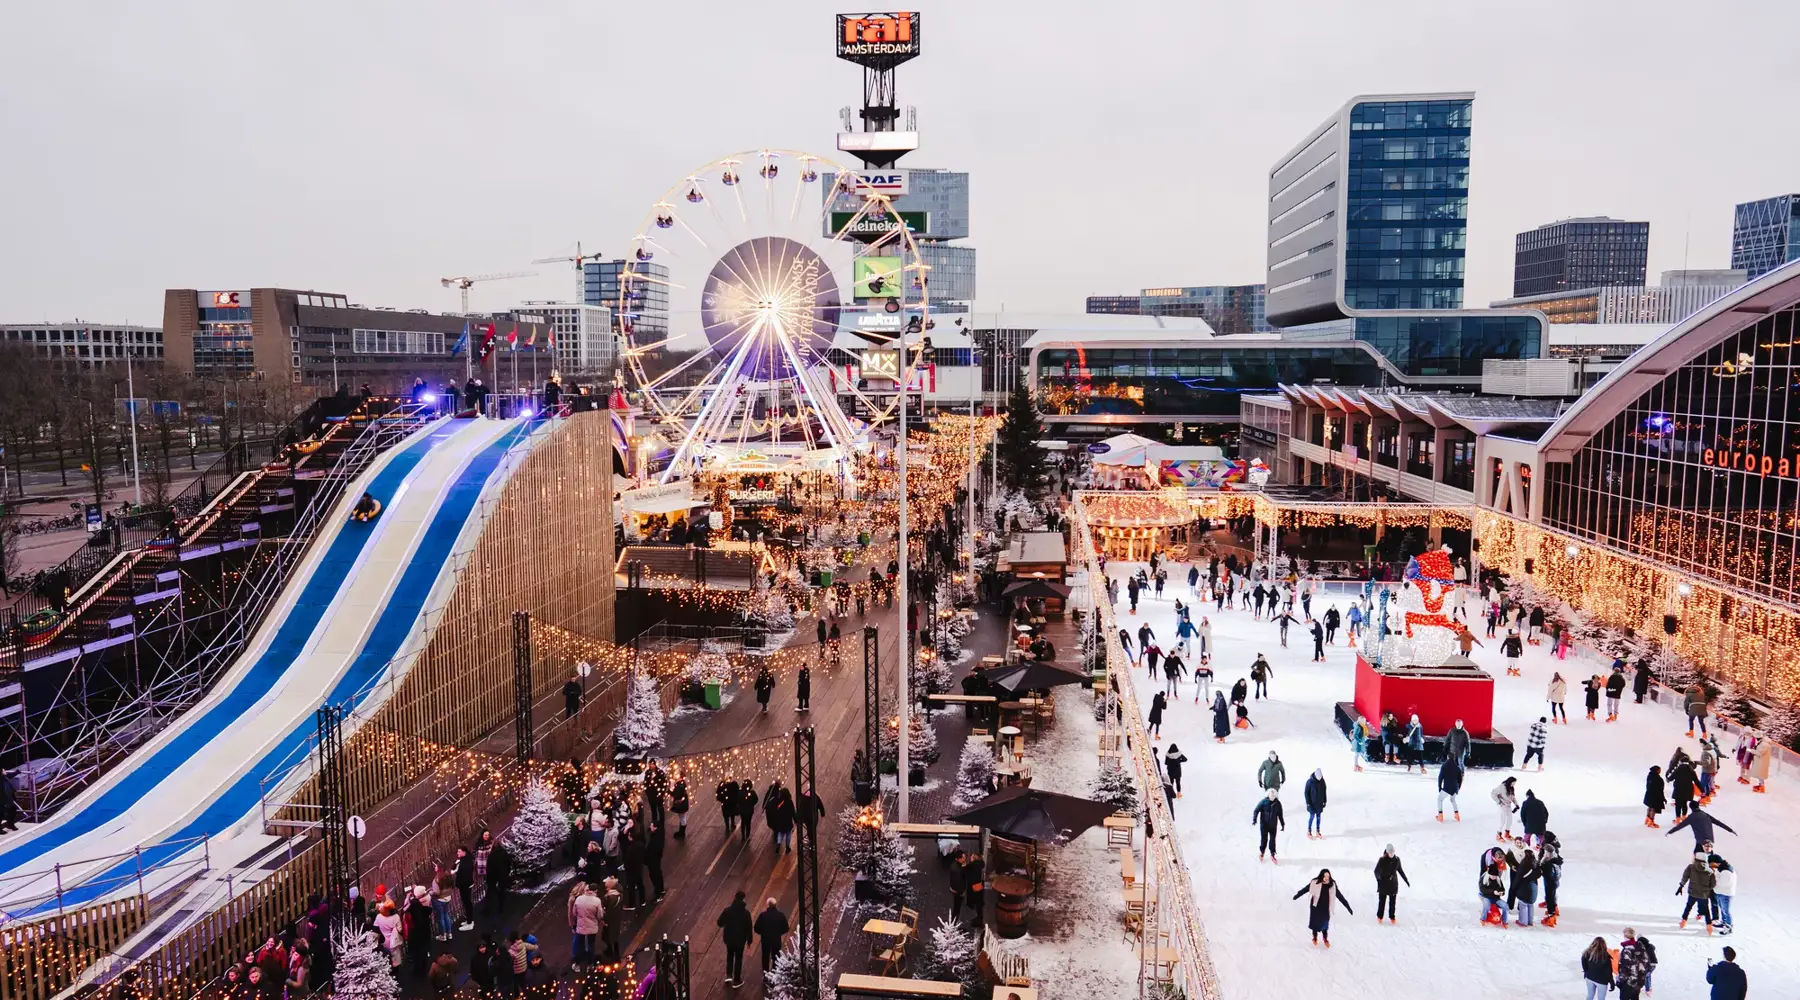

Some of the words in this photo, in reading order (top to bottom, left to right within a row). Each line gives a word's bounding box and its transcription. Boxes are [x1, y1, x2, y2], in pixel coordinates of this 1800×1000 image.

[845, 12, 910, 42] rai
[844, 44, 911, 54] AMSTERDAM
[856, 175, 902, 184] DAF
[862, 353, 897, 371] MX
